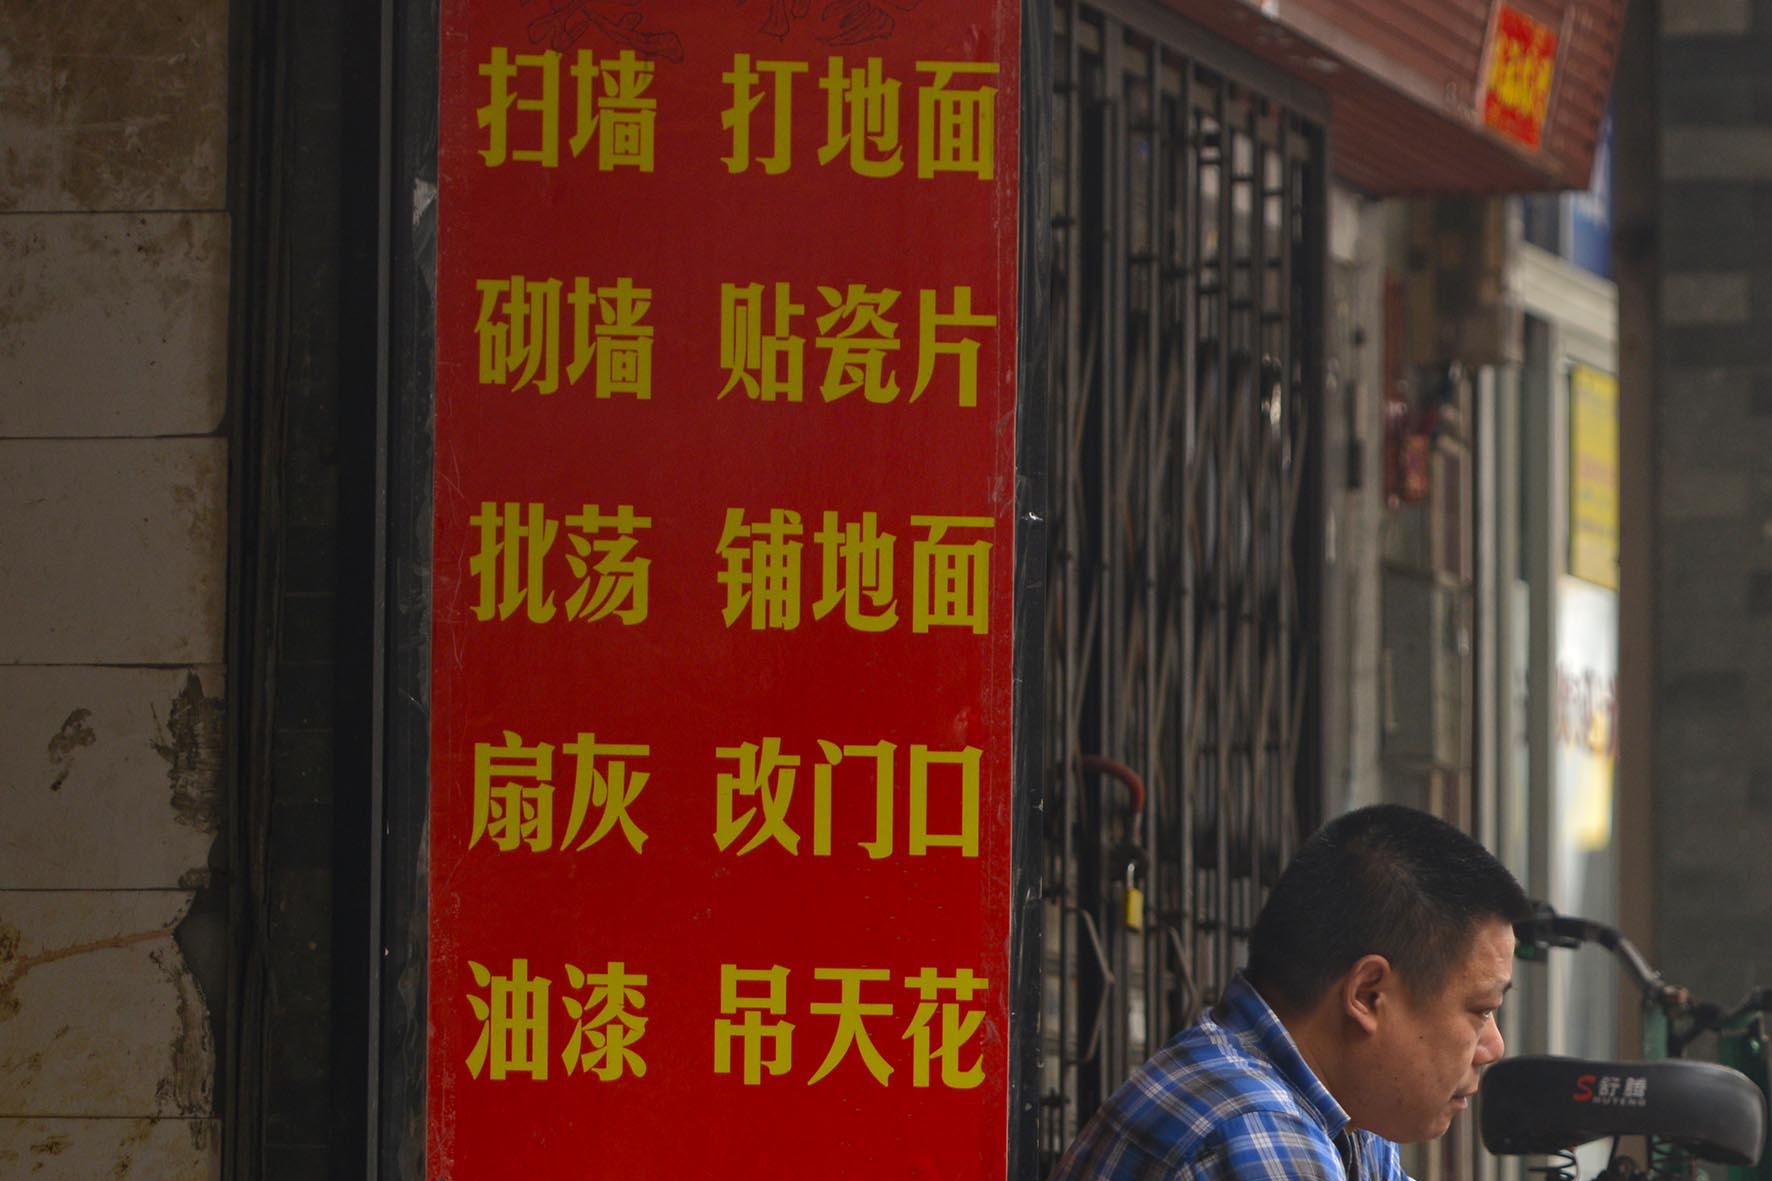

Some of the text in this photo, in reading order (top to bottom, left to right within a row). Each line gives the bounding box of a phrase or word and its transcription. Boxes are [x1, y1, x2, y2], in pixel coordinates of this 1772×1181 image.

[476, 46, 1000, 180] 扫墙 打地面
[474, 275, 997, 407] 砌墙 贴瓷片
[469, 502, 994, 635] 批荡 铺地面
[468, 730, 985, 859] 扇灰 改门口
[465, 958, 989, 1090] 油漆 吊天花
